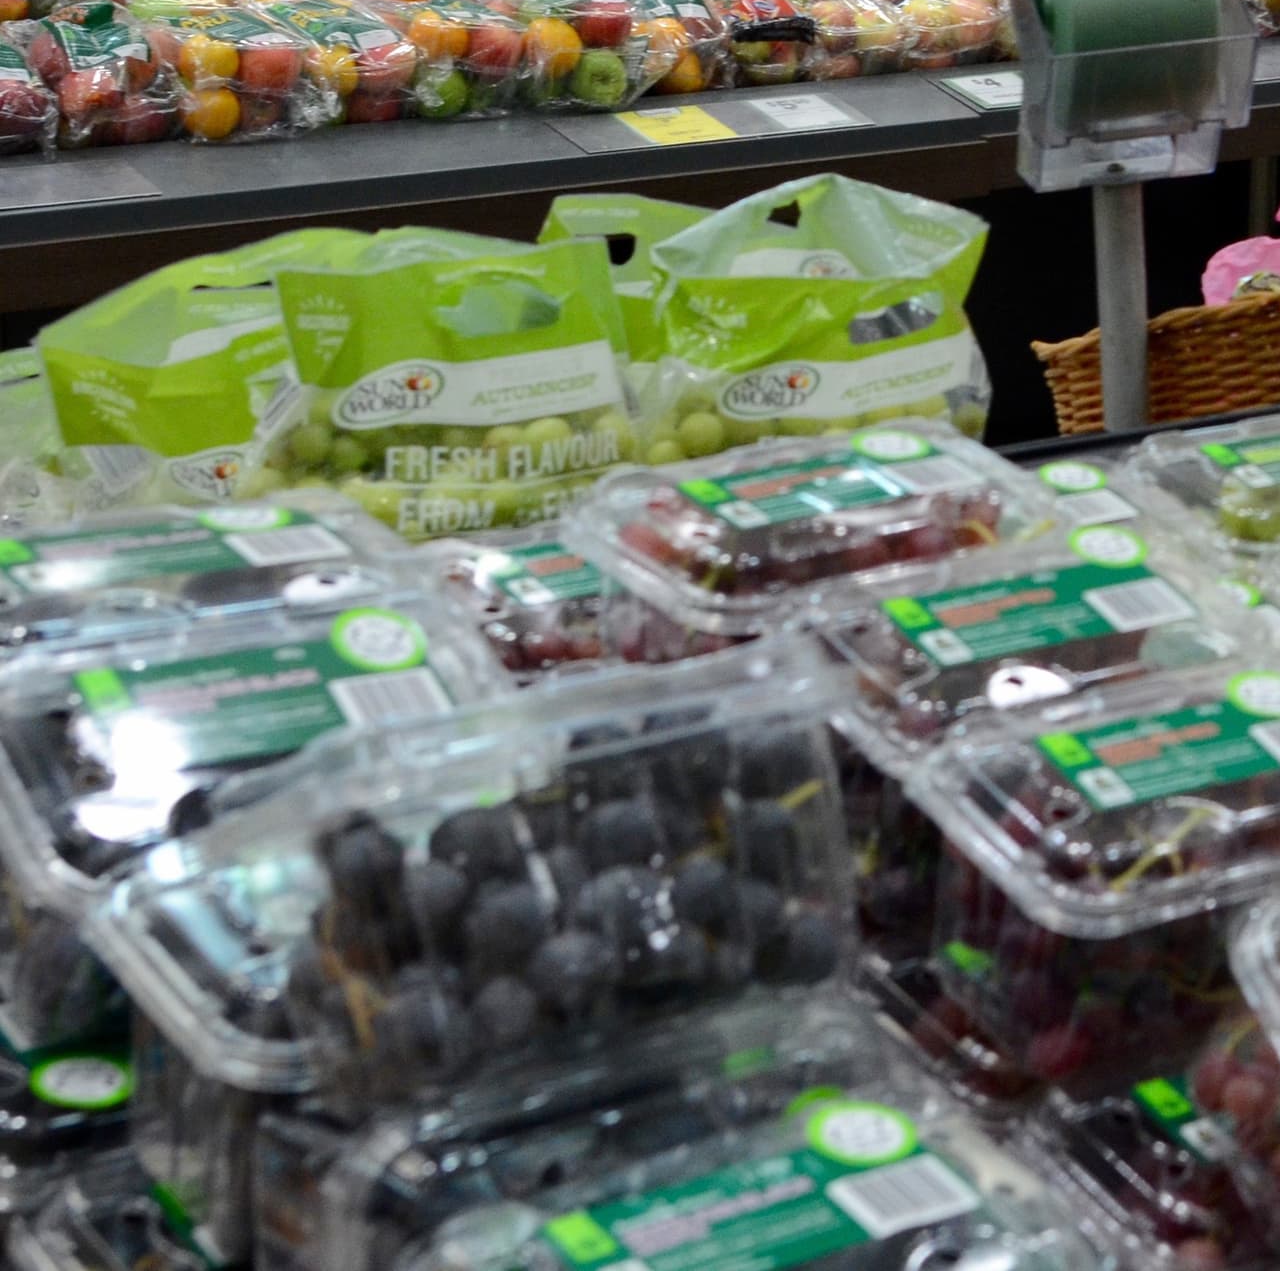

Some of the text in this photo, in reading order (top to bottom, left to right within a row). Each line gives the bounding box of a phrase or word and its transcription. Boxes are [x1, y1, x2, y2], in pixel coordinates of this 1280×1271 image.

[360, 377, 407, 396] SUN
[349, 393, 431, 415] WORLD
[731, 387, 810, 409] WORLD
[385, 427, 620, 483] FRESH FLAVOUR
[399, 497, 496, 532] FROM
